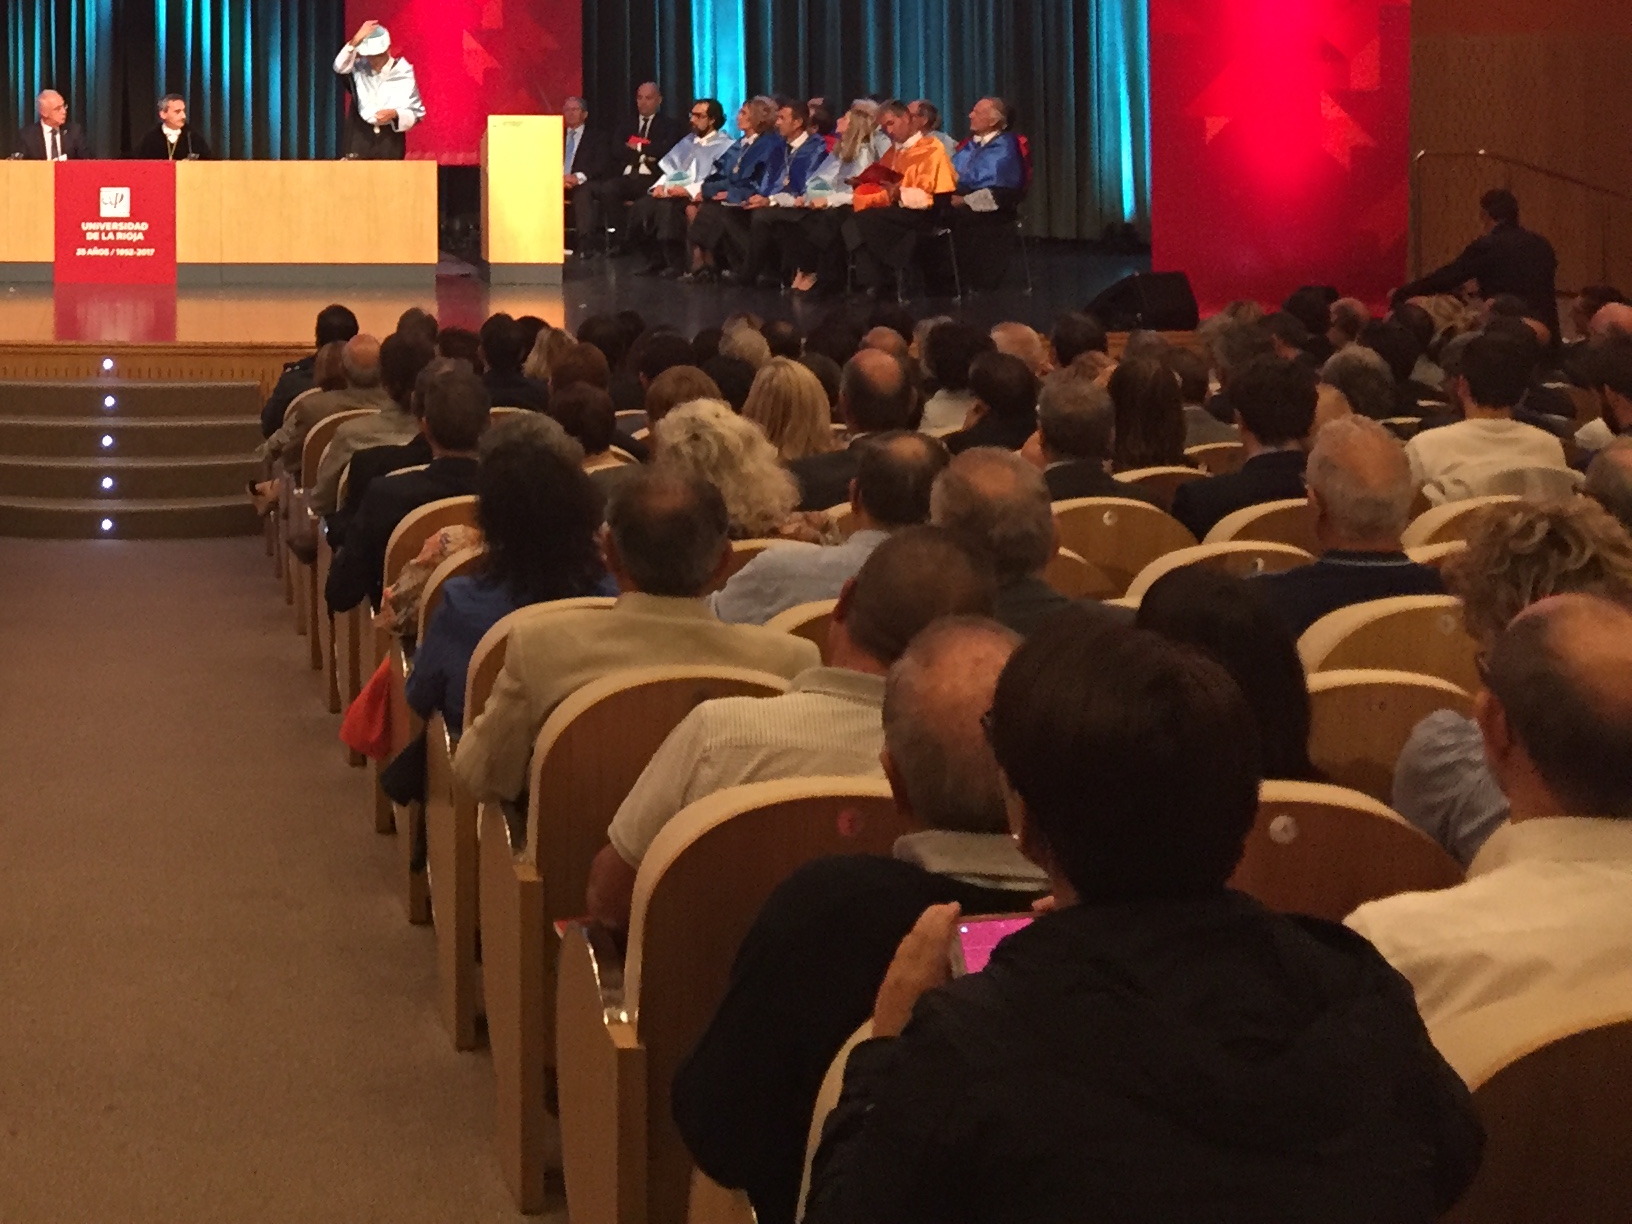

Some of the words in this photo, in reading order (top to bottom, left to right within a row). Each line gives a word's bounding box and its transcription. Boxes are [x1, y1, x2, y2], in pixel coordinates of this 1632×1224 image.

[81, 222, 149, 231] UNIVERSIDAD
[86, 232, 100, 240] DE
[101, 232, 115, 240] LA
[116, 232, 144, 242] RIOJA
